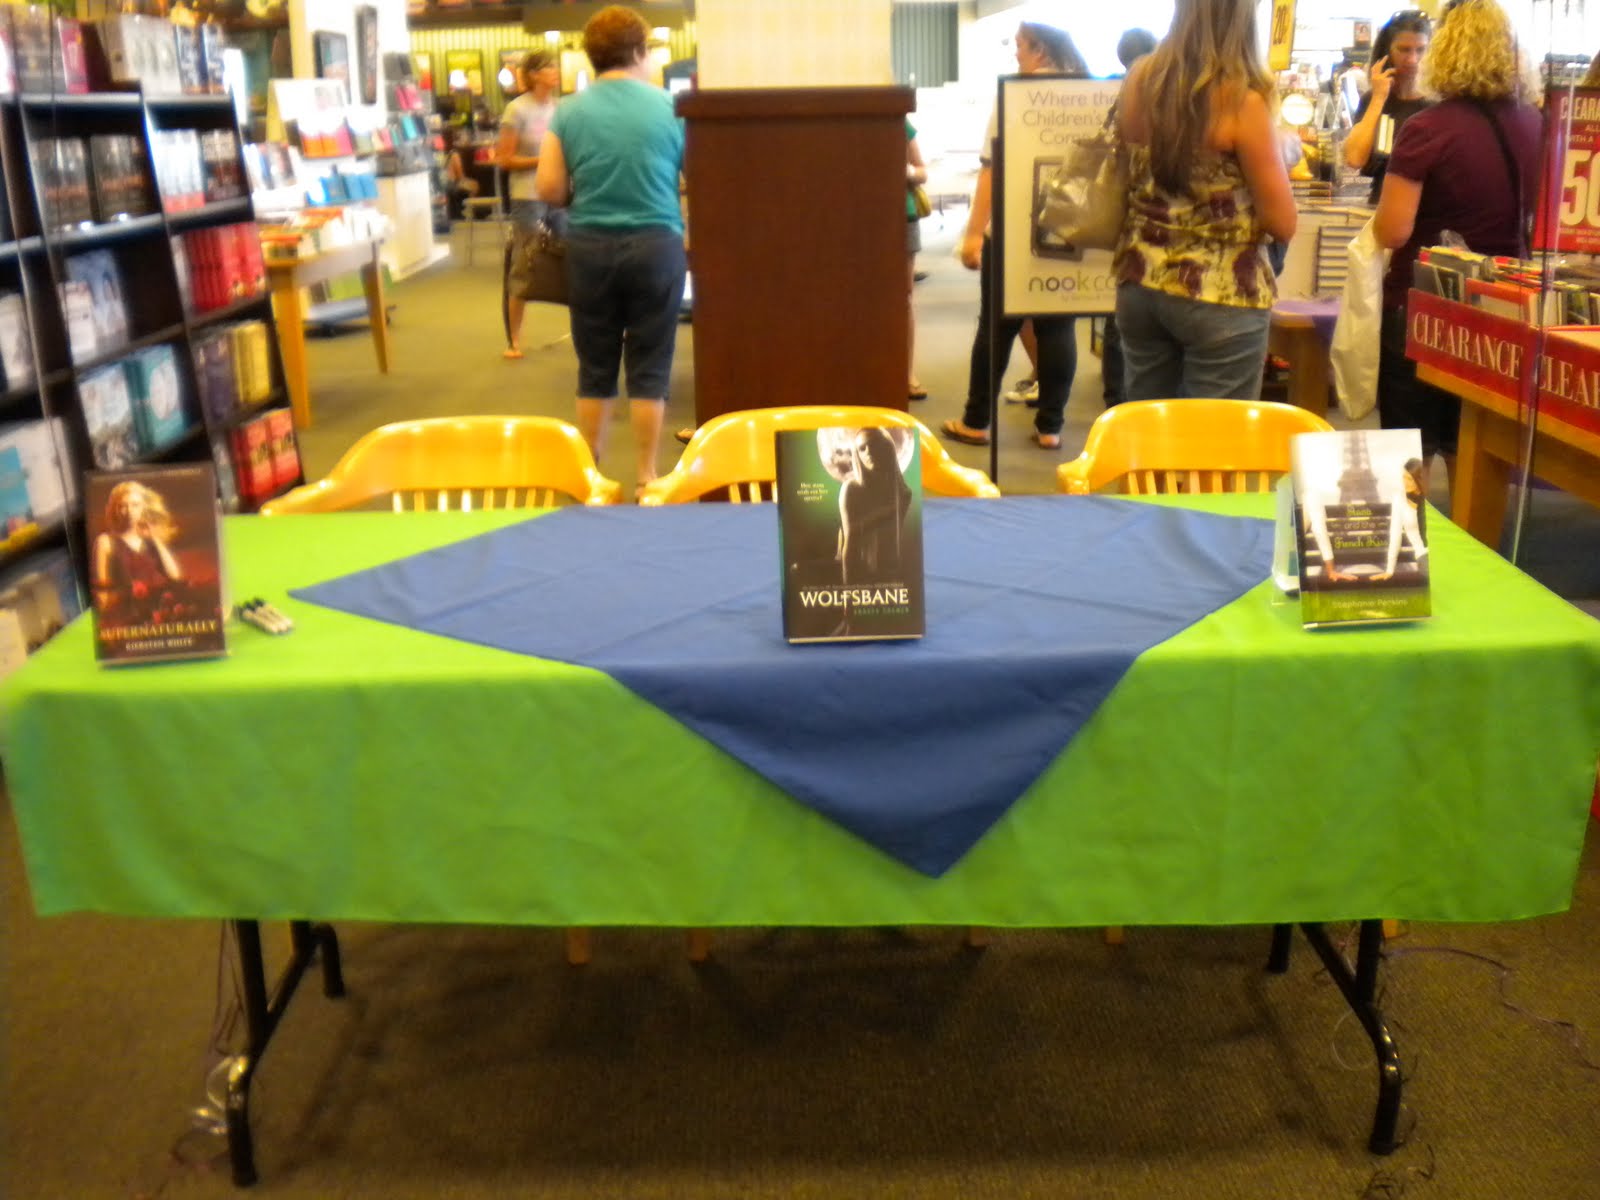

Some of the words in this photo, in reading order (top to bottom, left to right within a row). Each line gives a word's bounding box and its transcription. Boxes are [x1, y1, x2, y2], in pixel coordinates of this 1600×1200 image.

[1028, 89, 1087, 106] Where
[1022, 110, 1103, 126] Children's
[1413, 311, 1524, 381] CLEARANCE
[800, 588, 909, 609] WOLFSBANE
